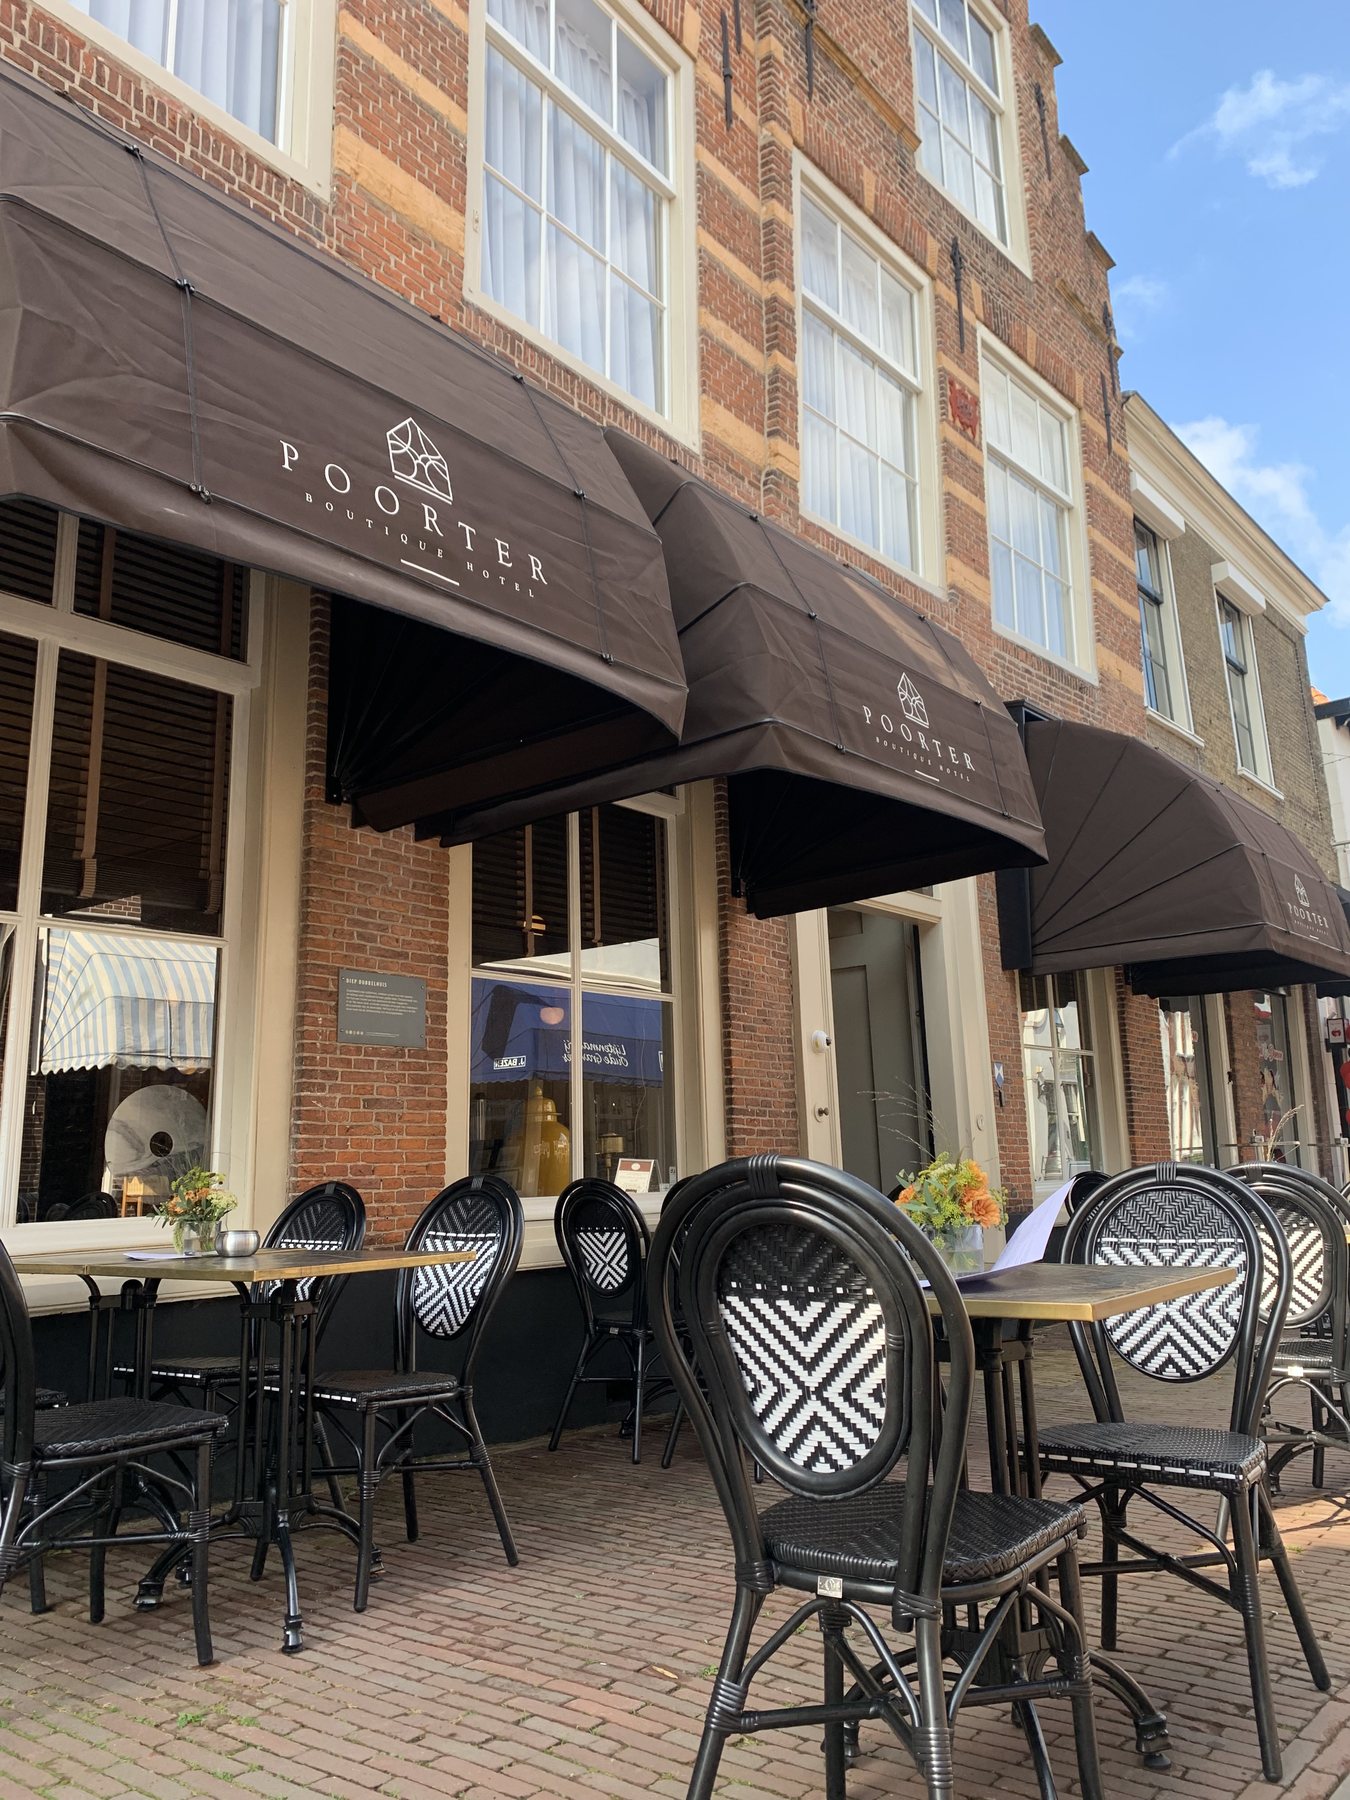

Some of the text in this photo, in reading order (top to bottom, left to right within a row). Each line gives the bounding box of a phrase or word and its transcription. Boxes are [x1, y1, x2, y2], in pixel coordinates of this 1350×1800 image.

[279, 439, 548, 585] POORTER
[305, 492, 535, 598] BOUTIQUE HOTEL
[862, 704, 976, 772] POORTER
